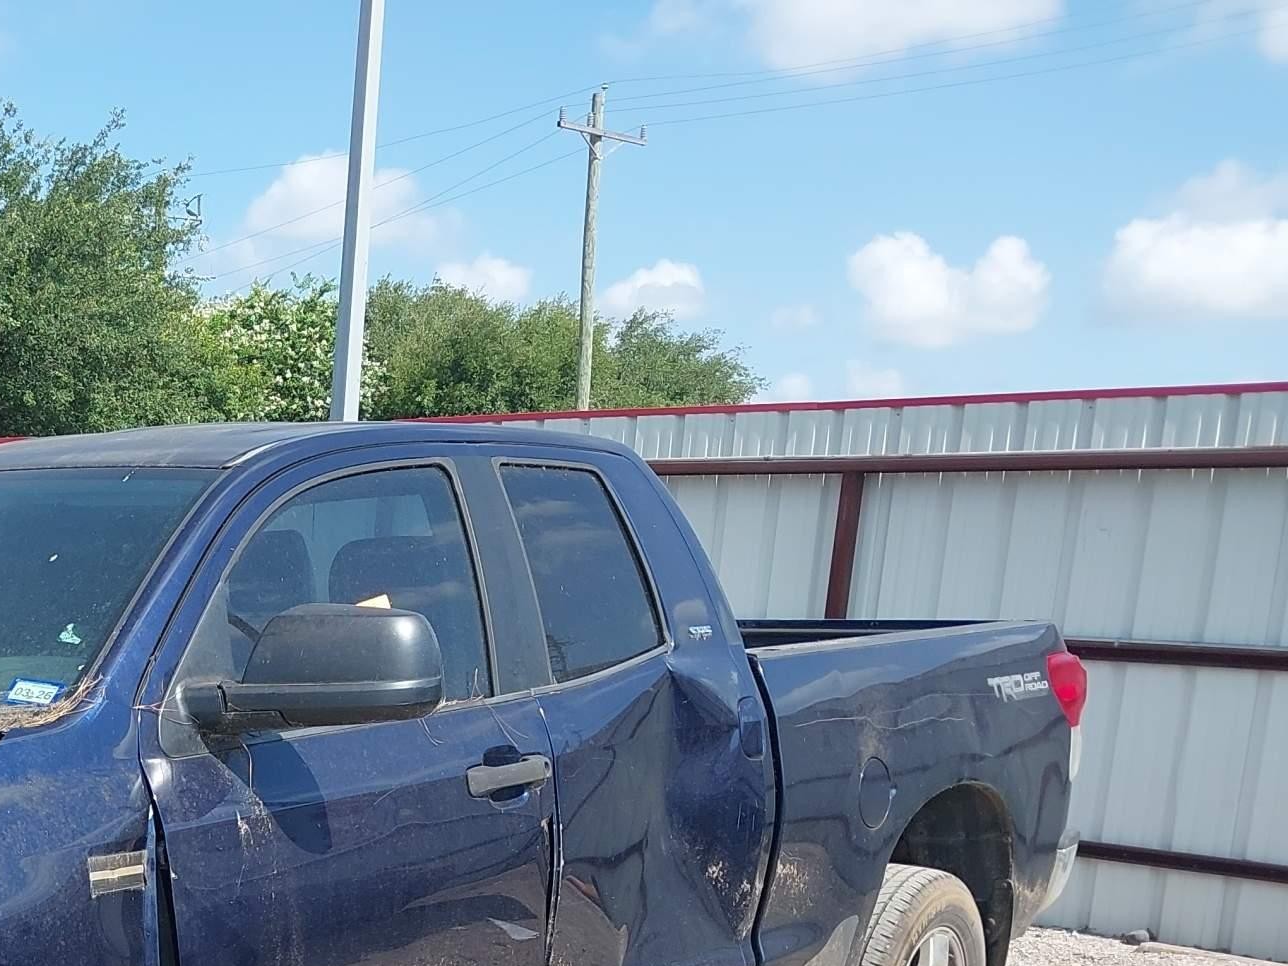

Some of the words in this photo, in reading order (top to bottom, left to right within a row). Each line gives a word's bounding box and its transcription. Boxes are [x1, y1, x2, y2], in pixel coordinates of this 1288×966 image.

[987, 675, 1024, 702] TRD
[1023, 672, 1040, 681] OFF
[1024, 680, 1049, 691] ROAD
